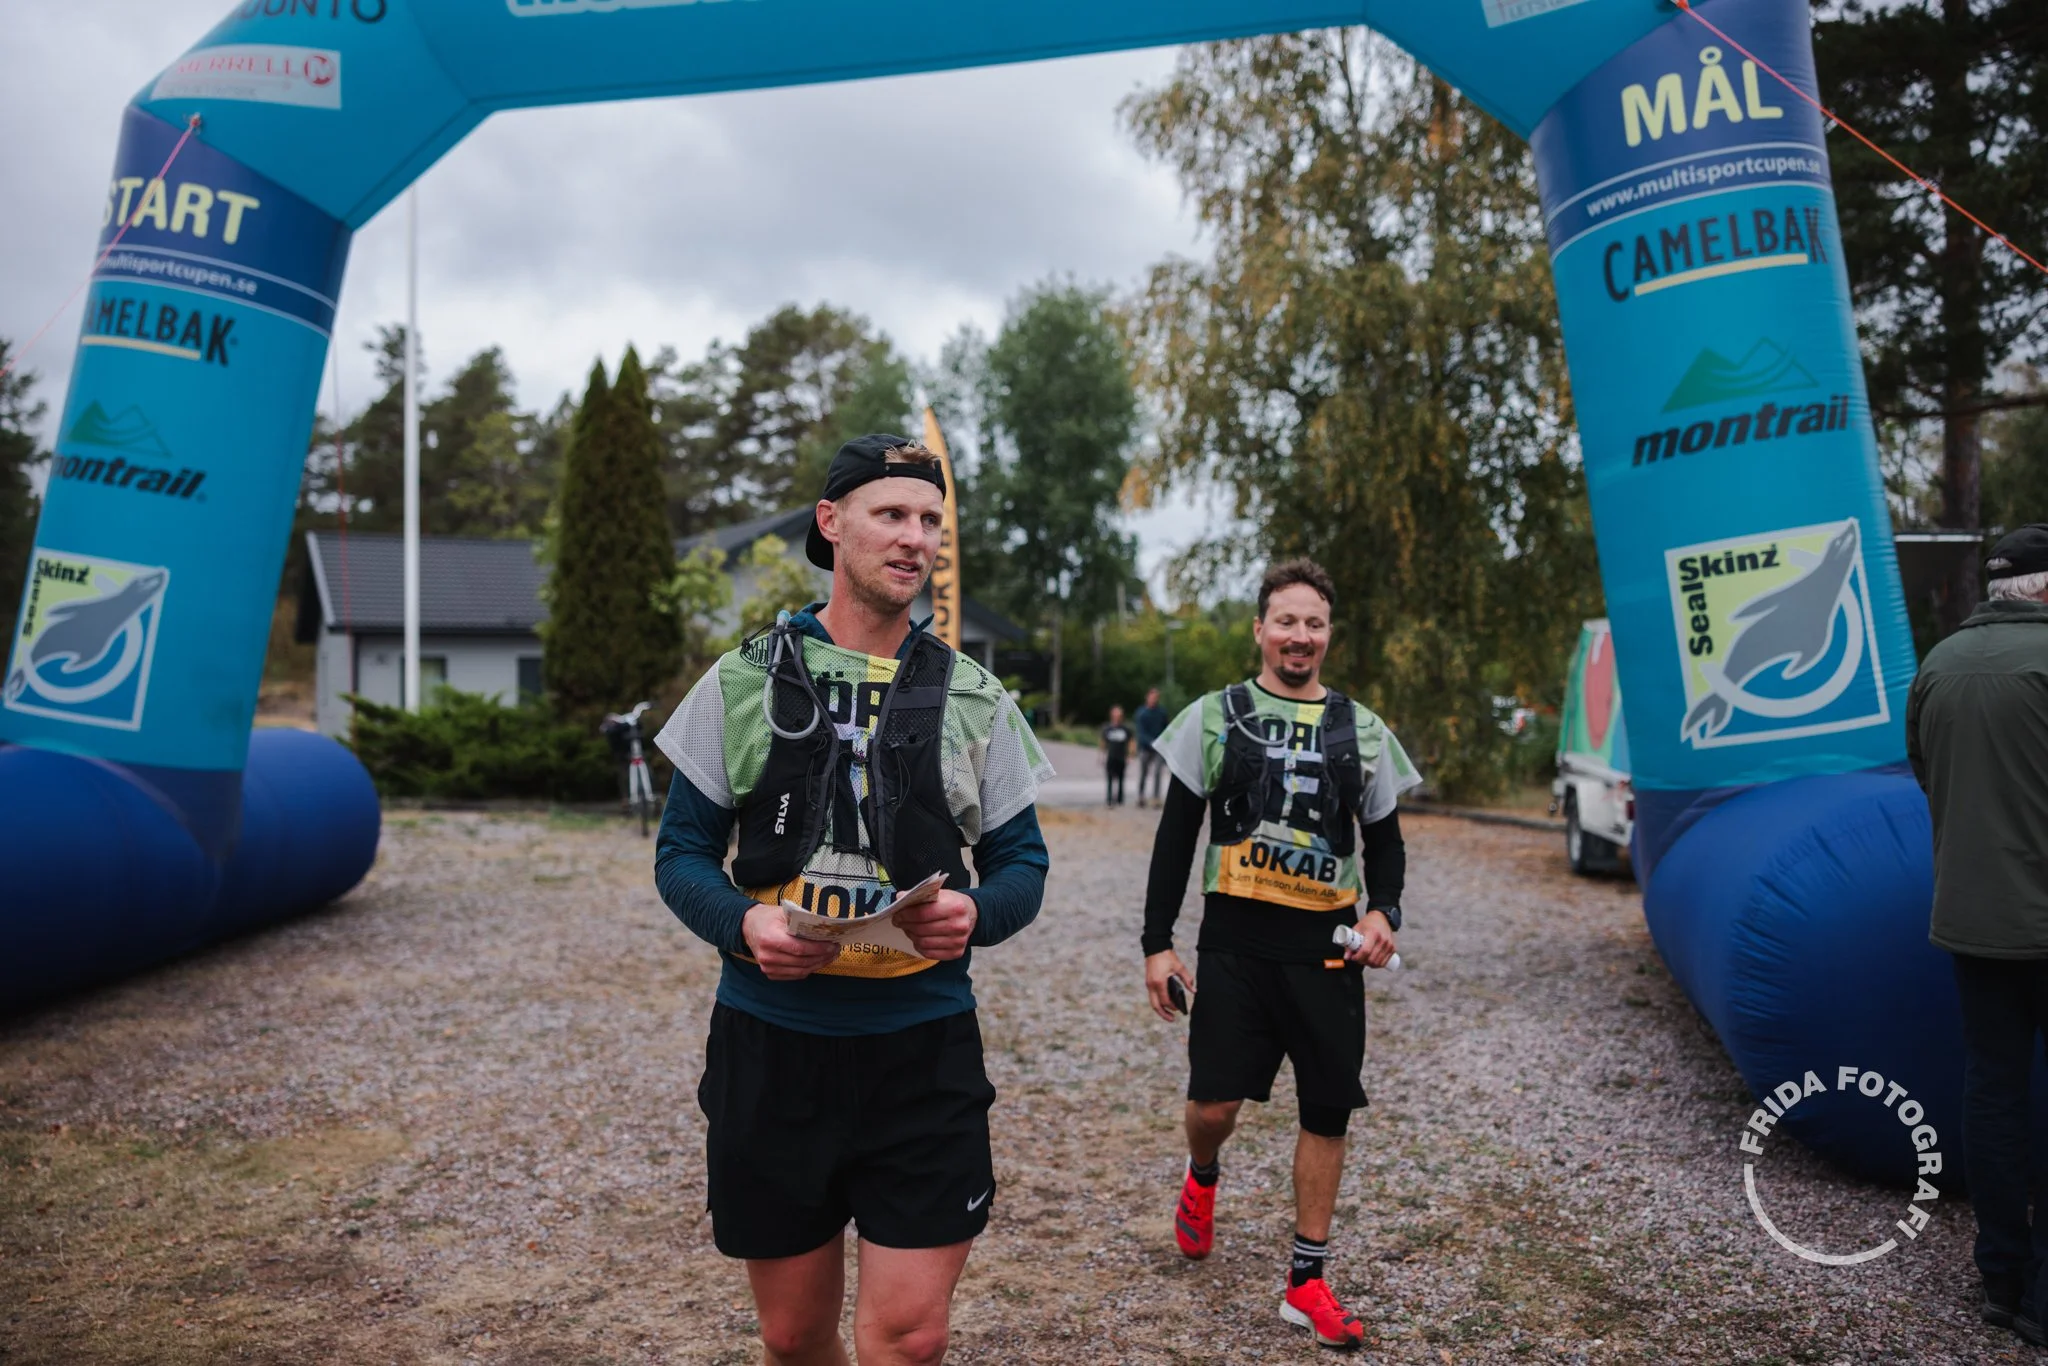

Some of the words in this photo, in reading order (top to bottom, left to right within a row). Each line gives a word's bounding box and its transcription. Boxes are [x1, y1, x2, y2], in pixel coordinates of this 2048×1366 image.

[1621, 46, 1784, 147] MÅL
[1586, 156, 1822, 217] www.multisportcupen.se
[1604, 207, 1829, 303] CAMELBAK
[1631, 395, 1849, 467] montrail
[1679, 545, 1780, 583] Skinz
[1681, 582, 1713, 657] Seal
[775, 792, 790, 835] SILVA
[1240, 842, 1337, 883] JOKAB
